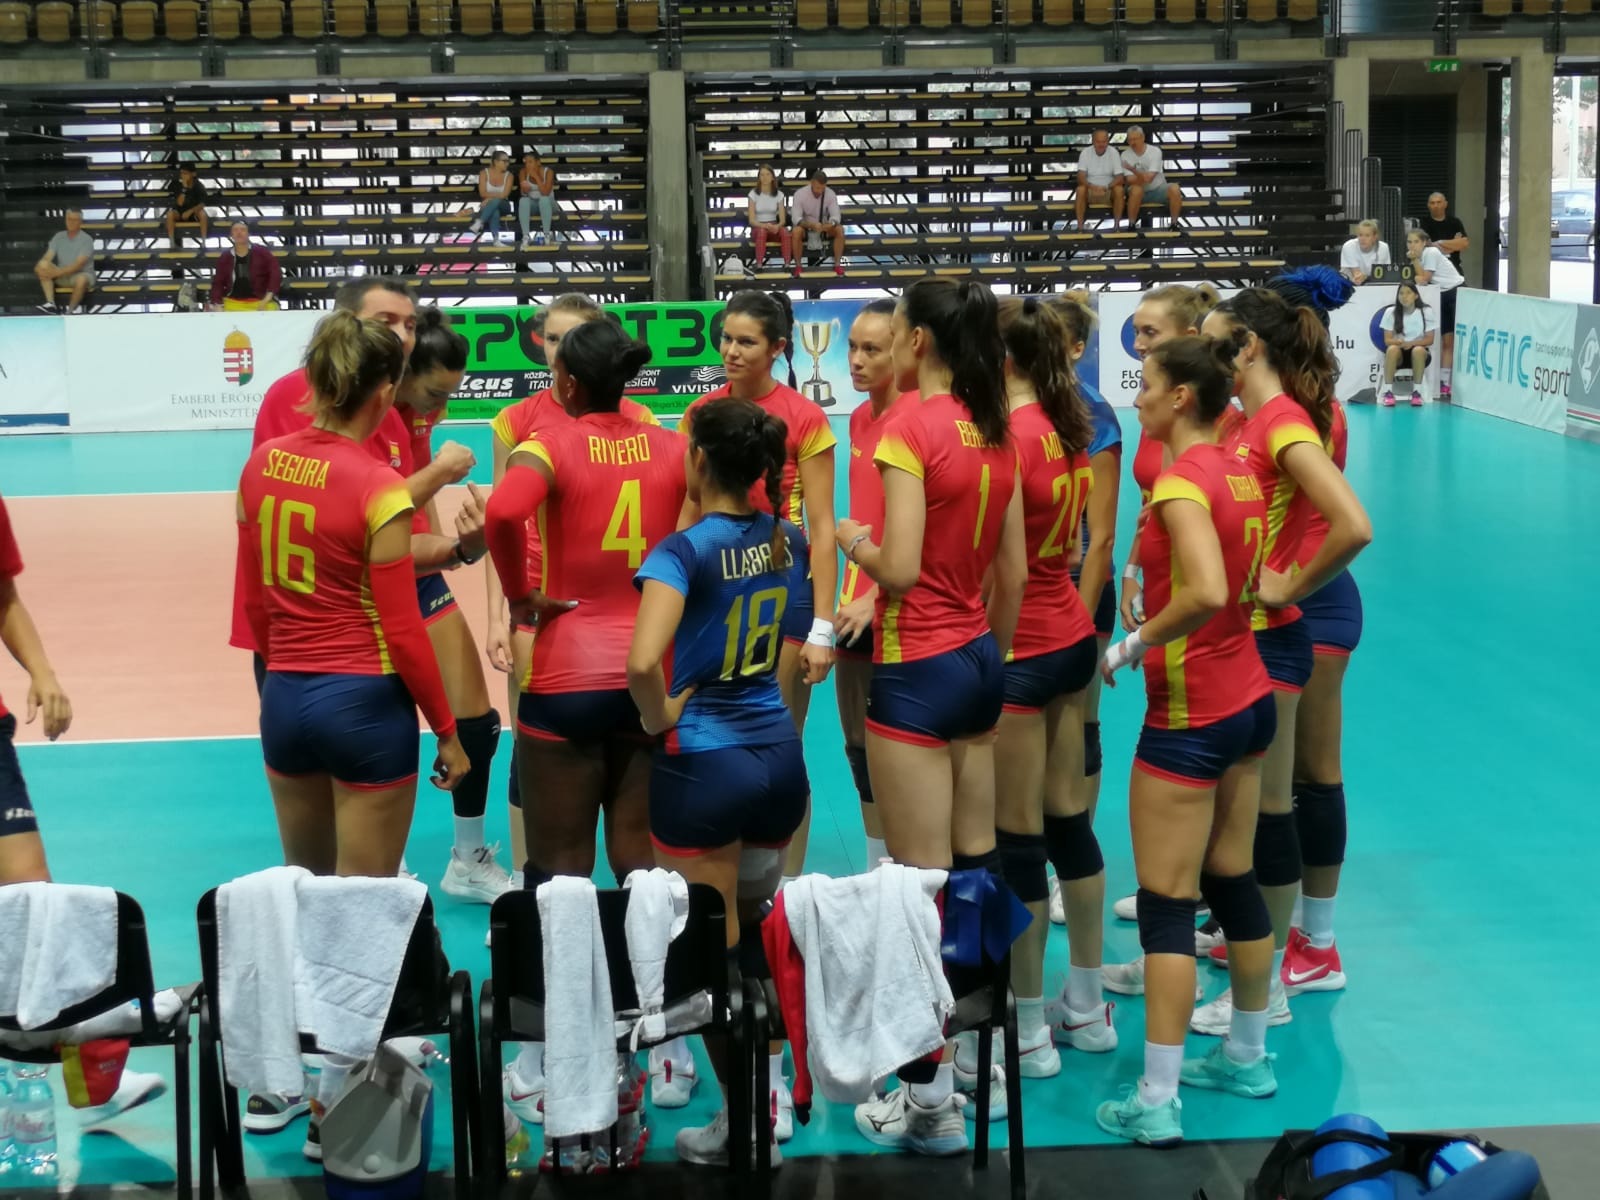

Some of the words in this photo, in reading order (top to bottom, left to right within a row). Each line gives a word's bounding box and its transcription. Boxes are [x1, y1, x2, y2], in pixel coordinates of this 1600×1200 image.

[1374, 266, 1384, 279] 0
[1402, 266, 1411, 280] 0
[1456, 323, 1532, 388] TACTIC
[171, 394, 216, 405] EMBERI
[625, 377, 656, 388] ESIGN
[1533, 366, 1571, 401] sport
[262, 448, 331, 490] SEGURA
[588, 433, 651, 465] RIVERO
[601, 479, 647, 569] 4
[973, 464, 990, 549] 1
[1038, 467, 1094, 558] 20
[257, 494, 316, 594] 16
[721, 536, 794, 580] LLABRS
[719, 586, 788, 682] 18
